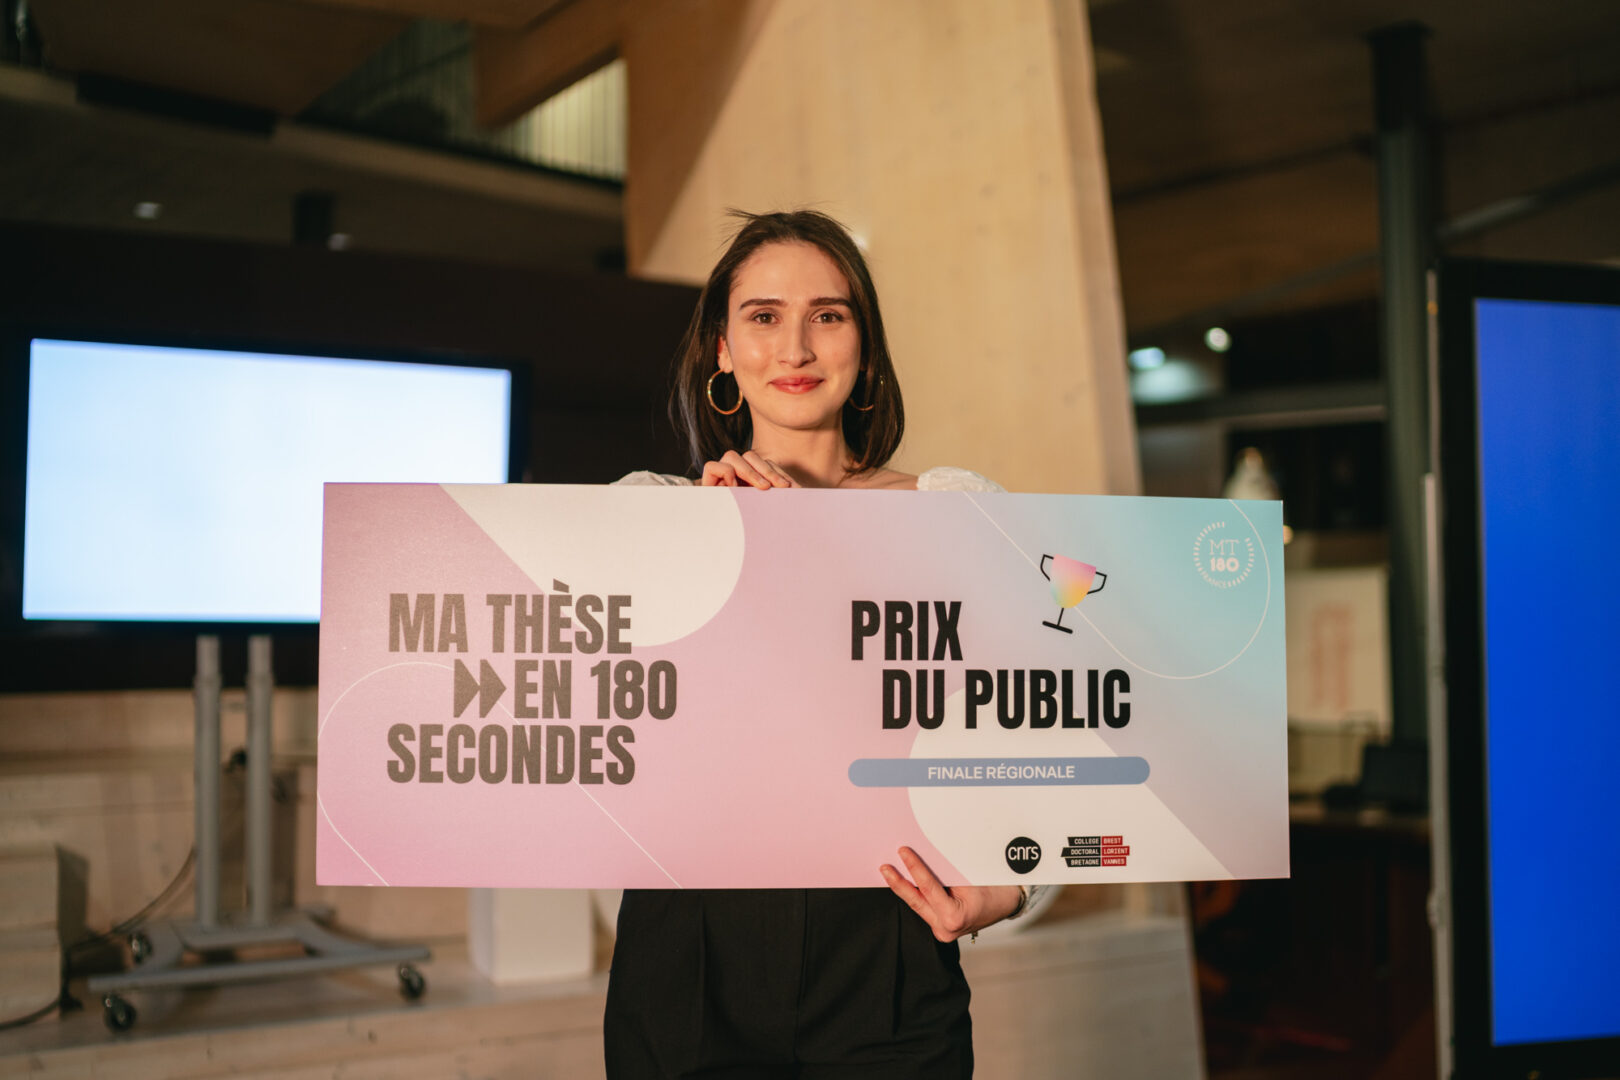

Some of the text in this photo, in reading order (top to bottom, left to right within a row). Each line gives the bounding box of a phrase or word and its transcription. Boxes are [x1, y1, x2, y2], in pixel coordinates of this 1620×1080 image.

[1208, 539, 1239, 555] MT
[1210, 557, 1239, 572] 180
[388, 578, 632, 654] MA THÈSE
[851, 600, 963, 661] PRIX
[514, 659, 678, 720] EN 180
[882, 669, 1132, 730] DU PUBLIC
[387, 723, 636, 785] SECONDES
[927, 763, 1075, 780] FINALE RÉGIONALE
[1008, 846, 1039, 861] cnrs
[1103, 847, 1128, 855] LORIENT
